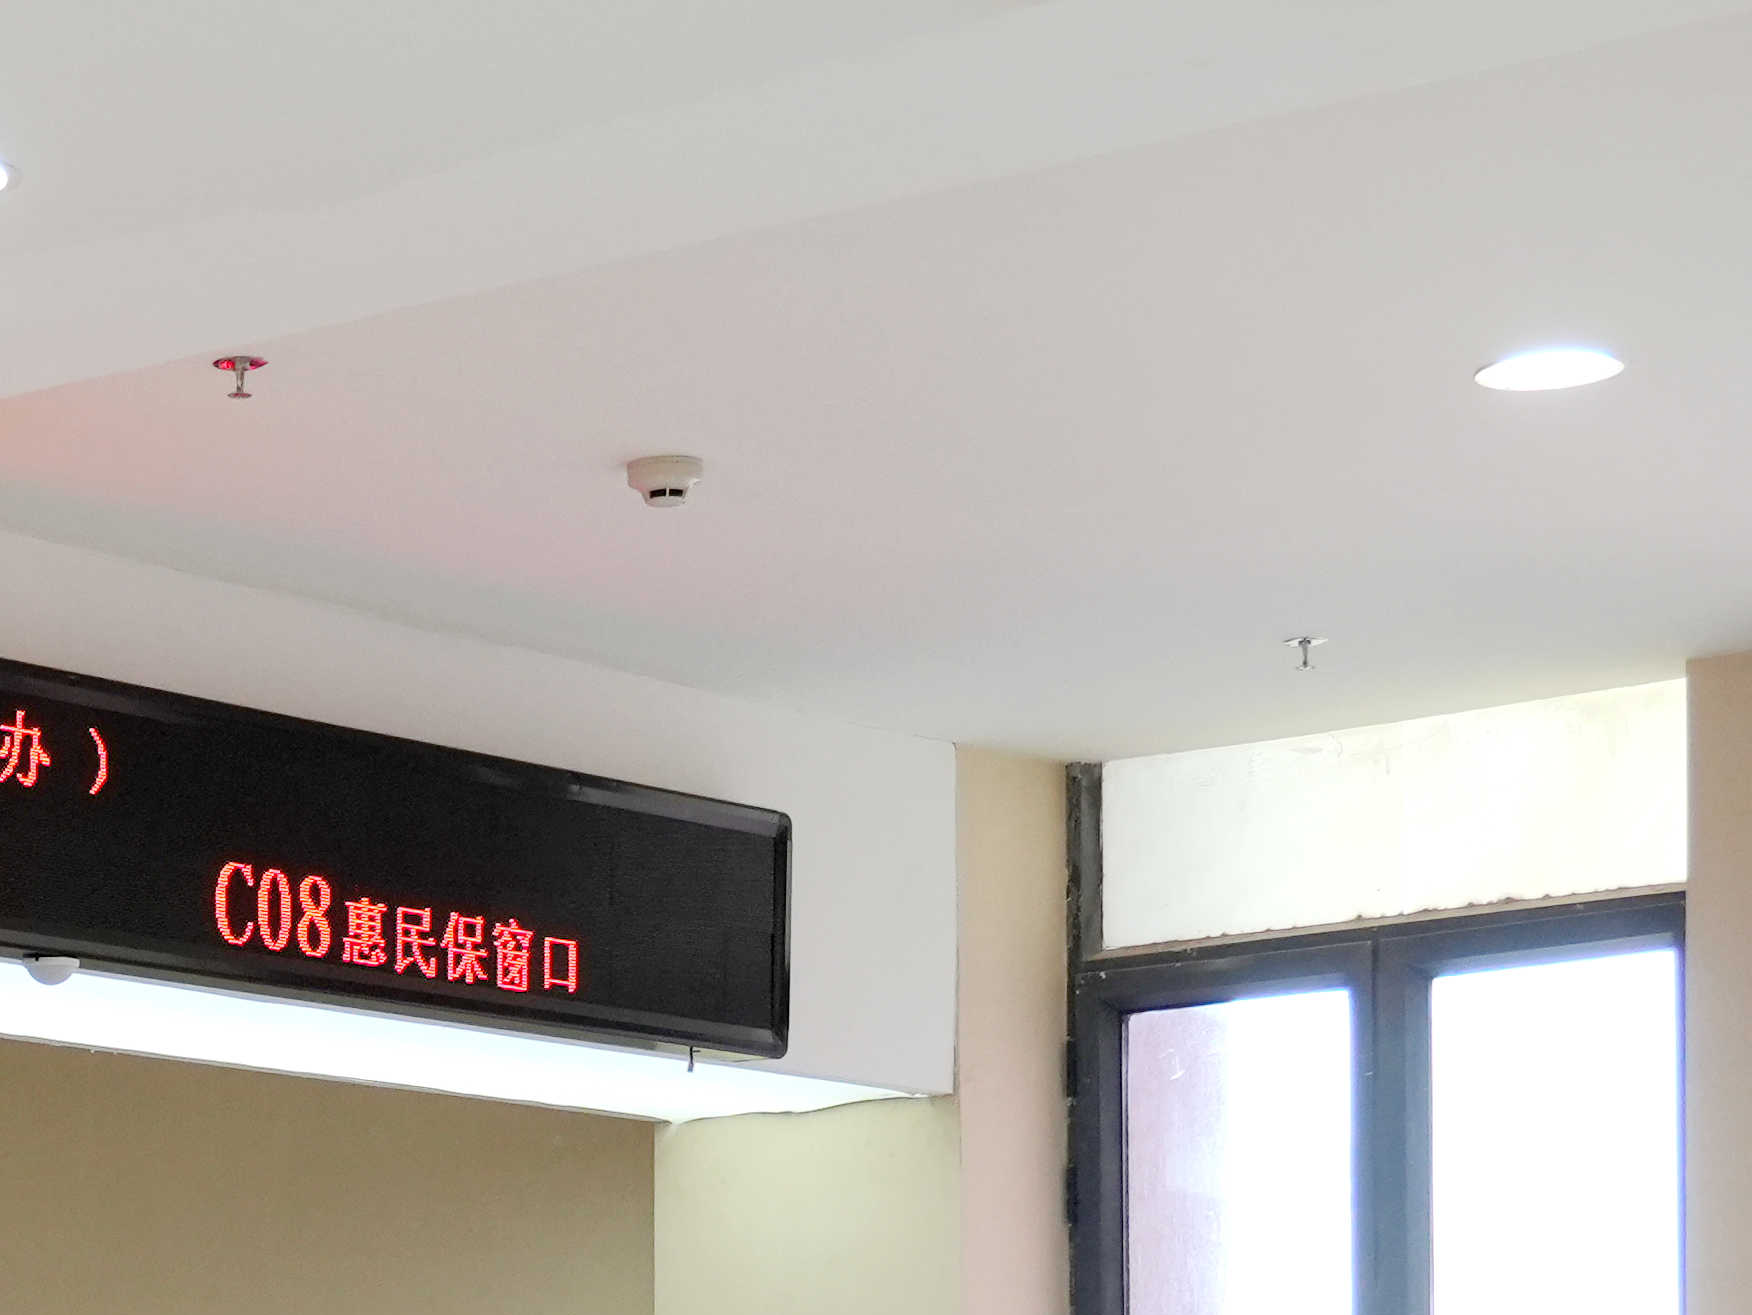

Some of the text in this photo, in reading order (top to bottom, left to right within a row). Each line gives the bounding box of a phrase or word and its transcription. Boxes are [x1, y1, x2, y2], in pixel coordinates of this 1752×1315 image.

[213, 861, 579, 993] C08惠民保窗口
